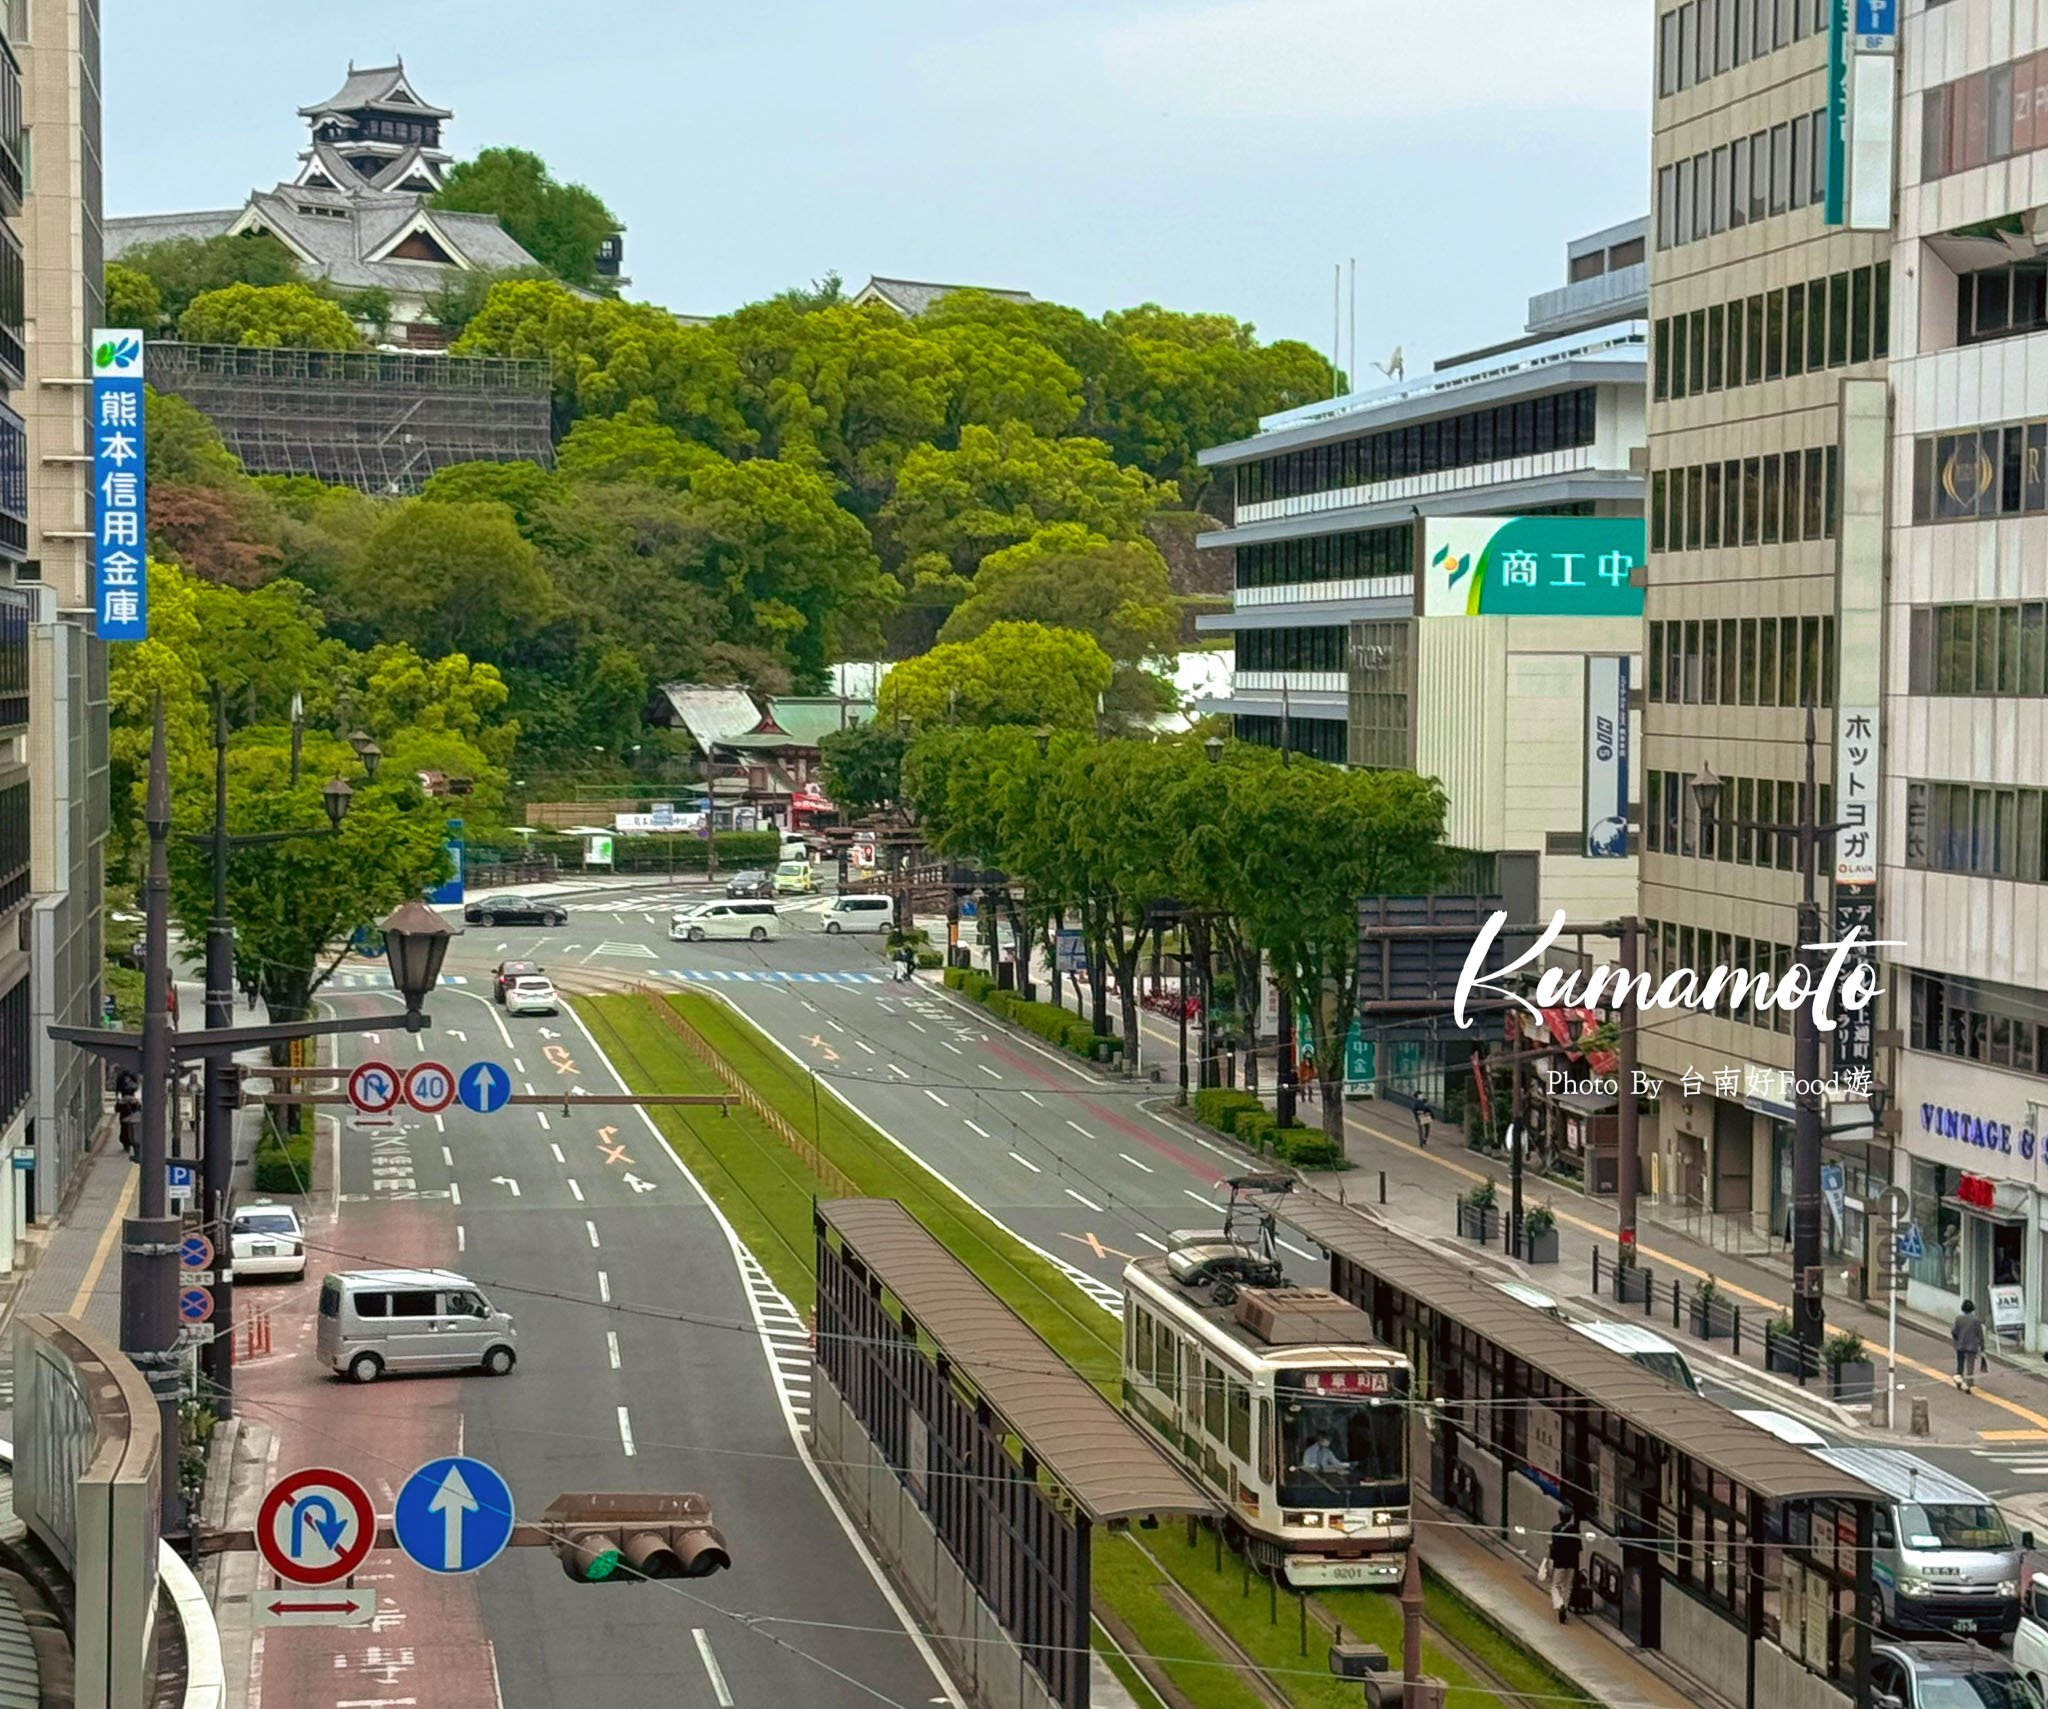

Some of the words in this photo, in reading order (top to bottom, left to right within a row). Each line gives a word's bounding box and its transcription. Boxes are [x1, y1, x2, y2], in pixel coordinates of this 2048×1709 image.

[100, 391, 139, 624] 熊本信用金庫
[1597, 715, 1614, 761] HIS
[1845, 714, 1872, 859] ホットヨガ
[1849, 864, 1874, 874] LAVA
[415, 1076, 444, 1099] 40
[1921, 1102, 2012, 1156] VINTAGE
[2019, 1128, 2035, 1160] &
[174, 1167, 187, 1184] P
[1333, 1567, 1362, 1580] 9201
